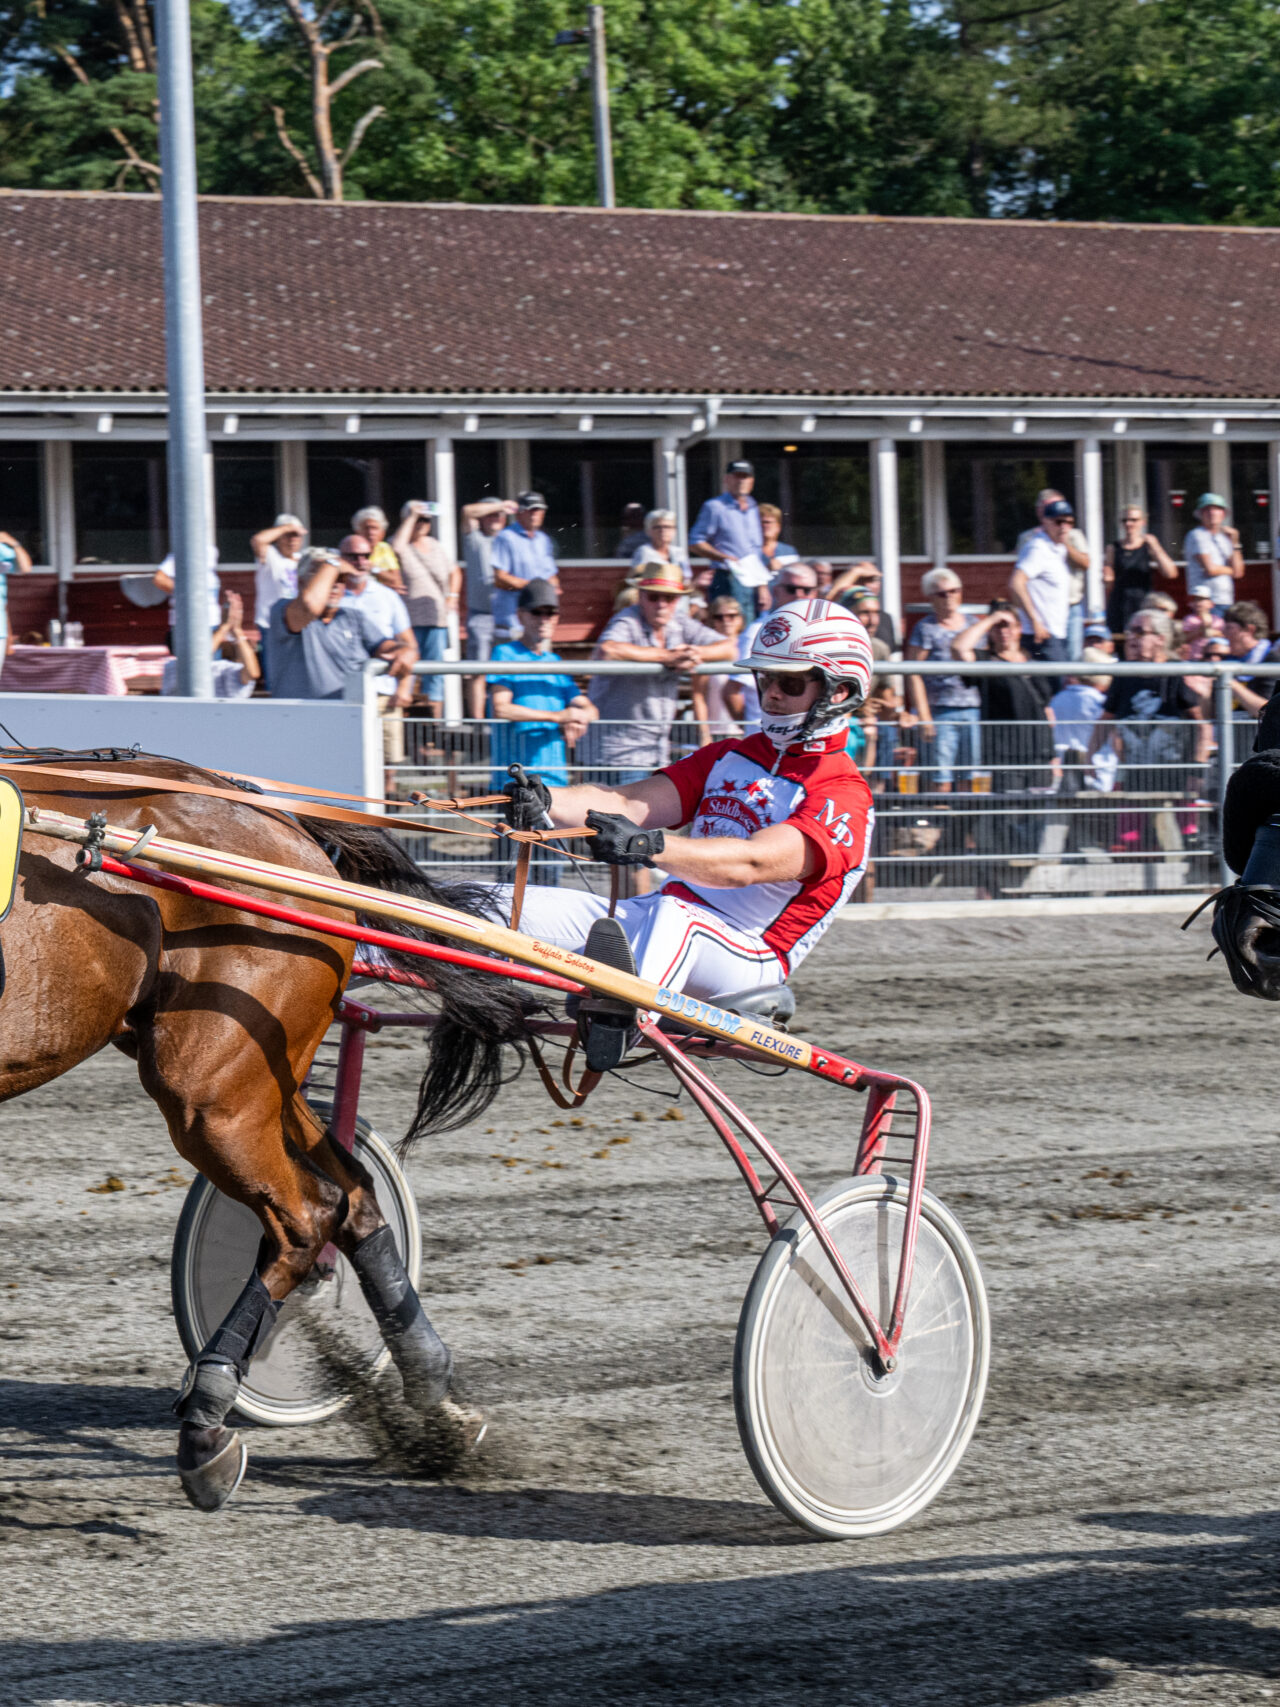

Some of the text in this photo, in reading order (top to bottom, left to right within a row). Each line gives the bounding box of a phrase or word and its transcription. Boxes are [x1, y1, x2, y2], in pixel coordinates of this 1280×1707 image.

[532, 941, 562, 960] Buffalo
[654, 988, 744, 1035] CUSTOM
[750, 1031, 803, 1060] FLEXURE
